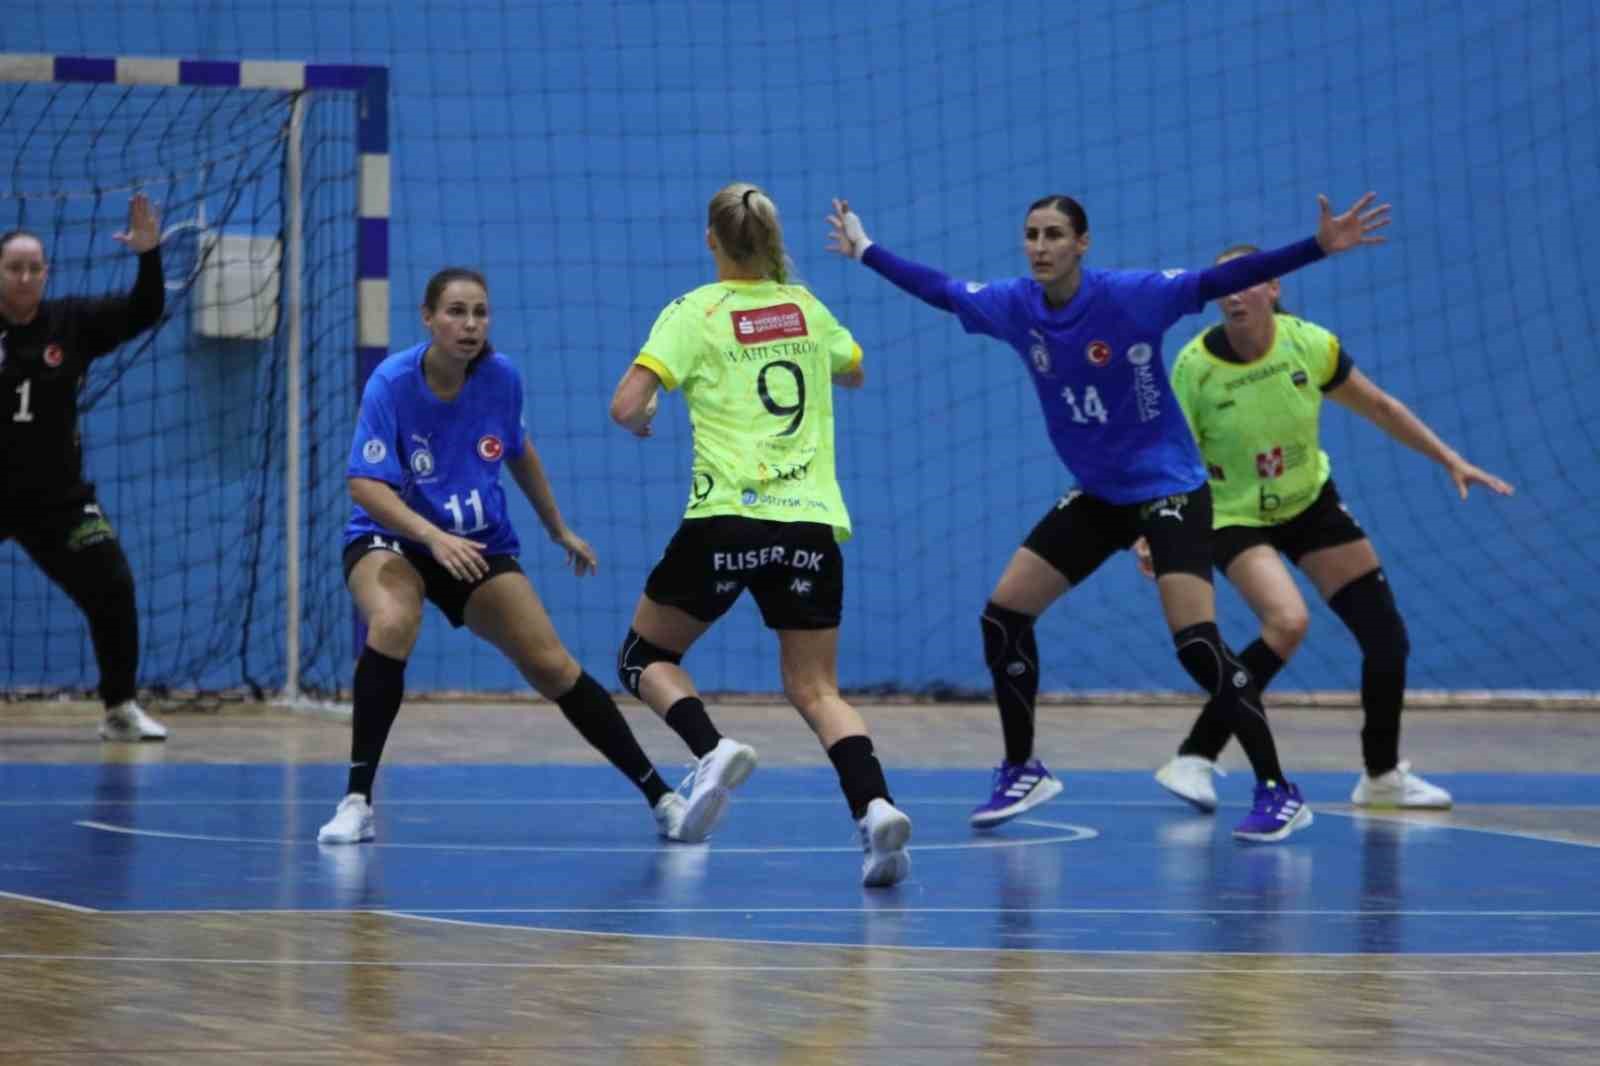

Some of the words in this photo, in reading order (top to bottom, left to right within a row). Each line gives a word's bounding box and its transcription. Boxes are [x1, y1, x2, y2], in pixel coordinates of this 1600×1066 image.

[12, 379, 33, 422] 1
[757, 360, 805, 437] 9
[1061, 385, 1108, 424] 14
[443, 488, 489, 535] 11
[713, 545, 824, 572] FLISER.DK
